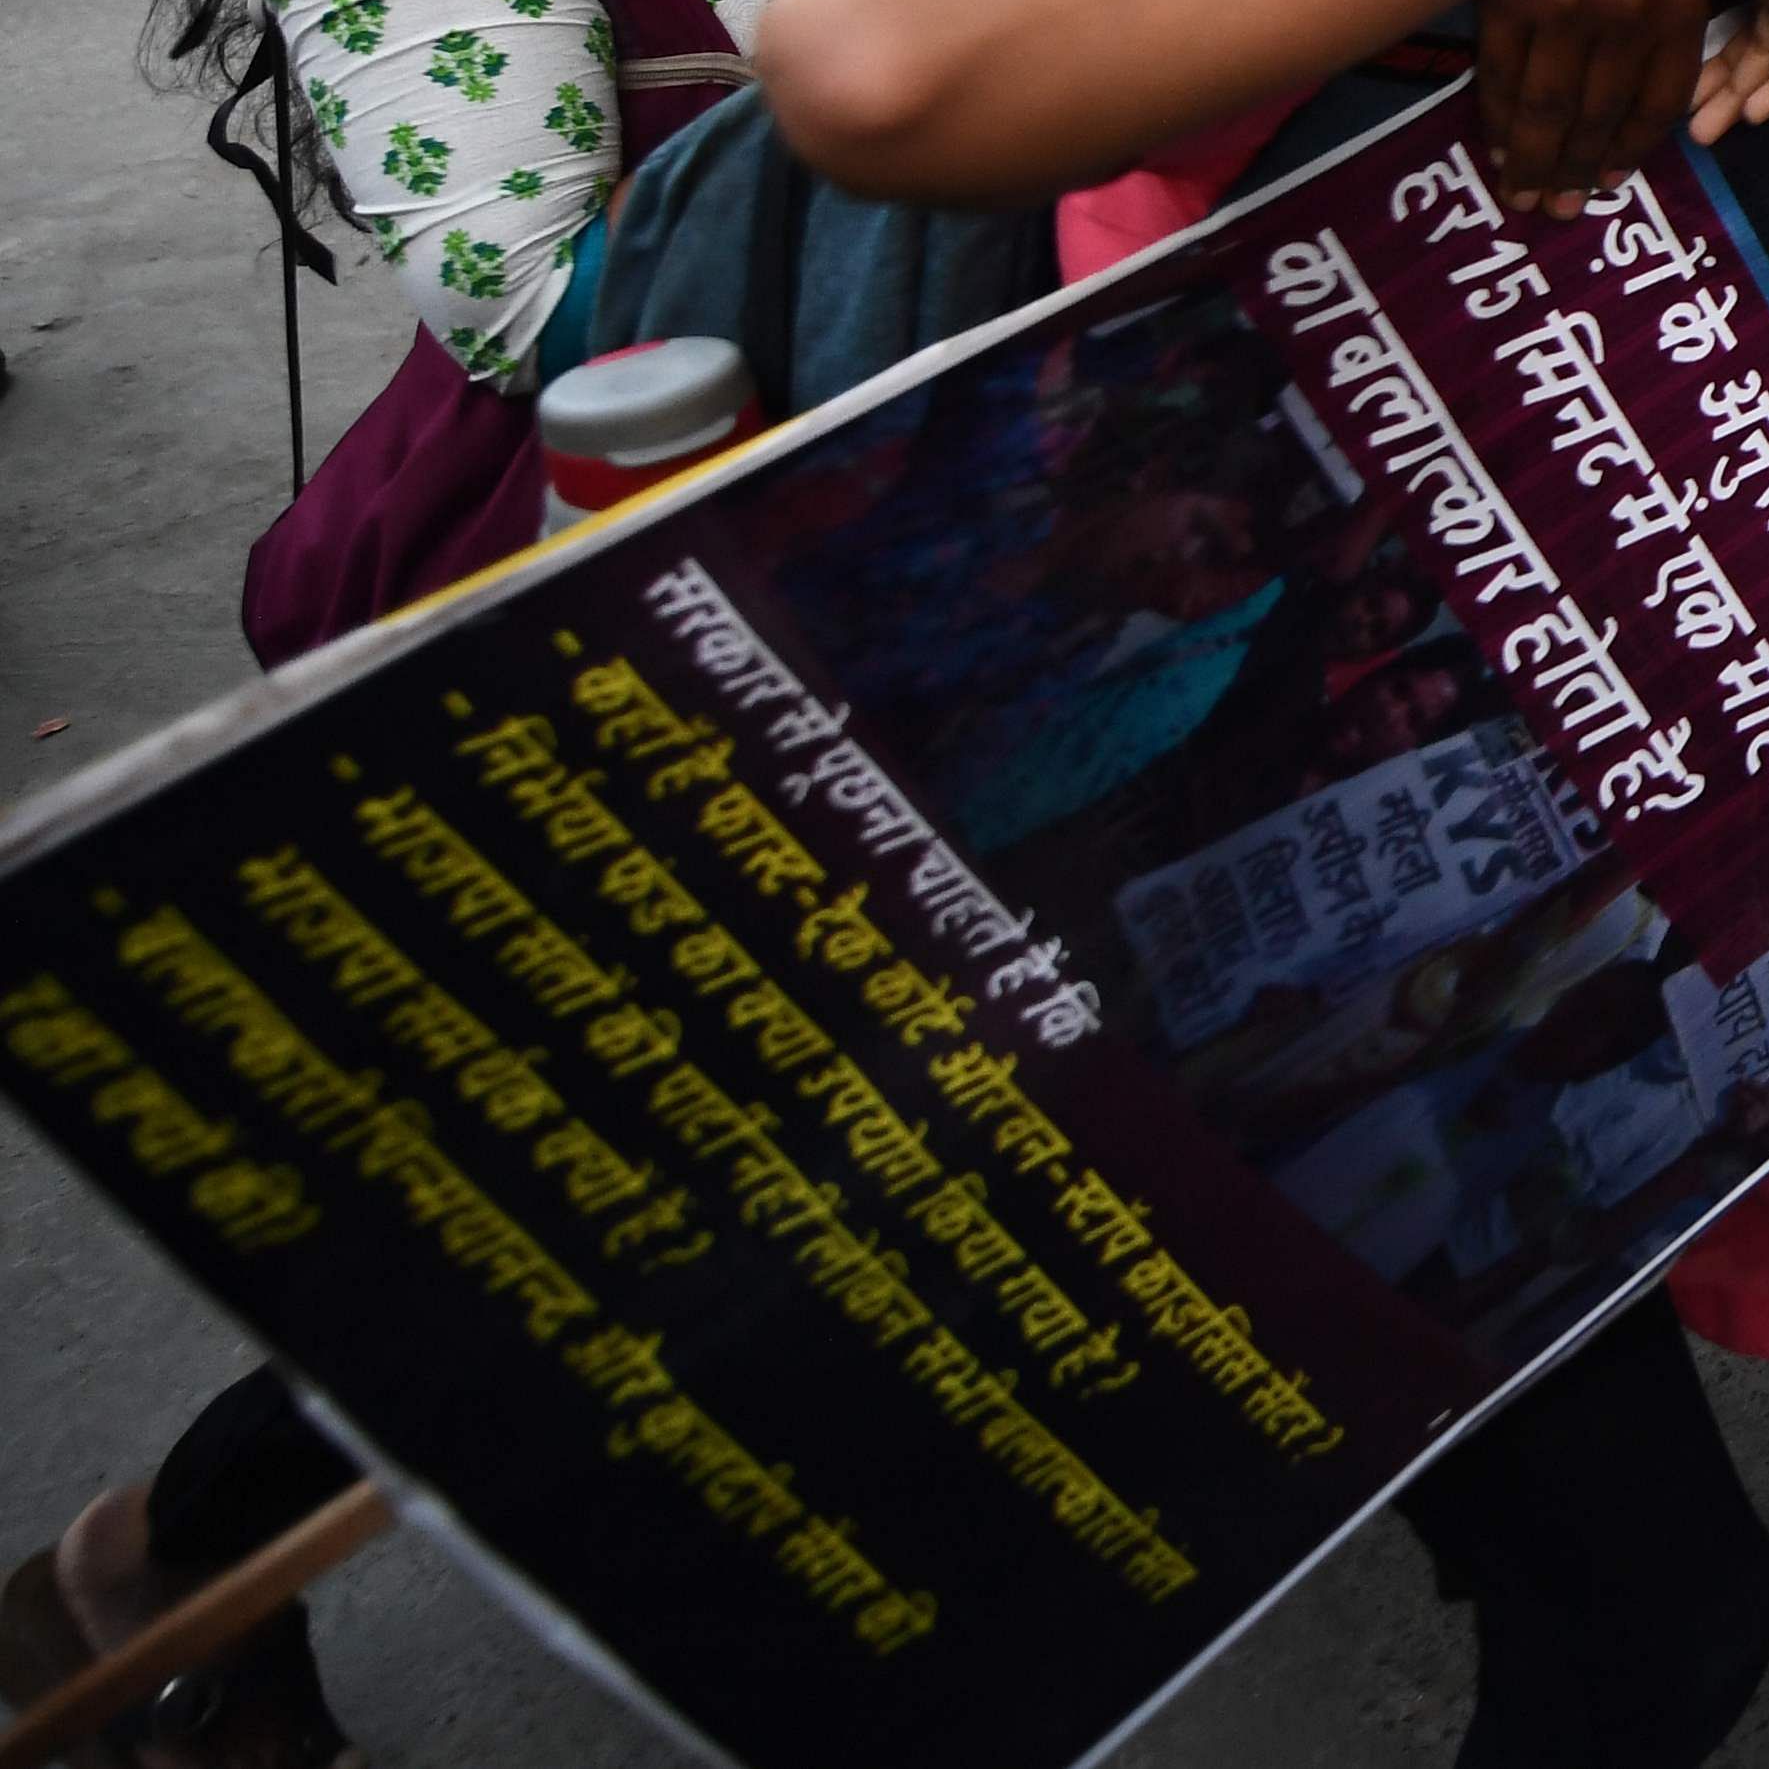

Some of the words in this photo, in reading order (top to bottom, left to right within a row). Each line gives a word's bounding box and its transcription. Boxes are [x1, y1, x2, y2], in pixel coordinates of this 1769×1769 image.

[1393, 142, 1503, 241] हर
[1450, 240, 1549, 317] 15
[1658, 285, 1737, 361] के
[1495, 309, 1654, 485] मिनट
[1269, 229, 1377, 331] का
[1331, 313, 1559, 601] बलात्कार
[1503, 595, 1650, 750] होता
[1599, 717, 1704, 819] है?
[1611, 472, 1707, 548] में
[647, 558, 803, 705] सरकार
[1644, 535, 1755, 647] एक
[769, 697, 848, 748] से
[784, 740, 934, 852] पूछना
[1420, 746, 1526, 894] KYS
[238, 847, 421, 1001] भाजपा
[358, 786, 534, 934] भाजपा
[587, 1003, 680, 1074] की
[911, 838, 1033, 955] चाहते
[459, 715, 631, 859] निर्भया
[673, 923, 760, 993] का
[729, 979, 833, 1068] क्या
[799, 1055, 940, 1194] उपयोग
[907, 1173, 1023, 1279] किया
[999, 1264, 1087, 1349] गया
[864, 960, 973, 1044] कोर्ट
[1022, 981, 1099, 1045] कि
